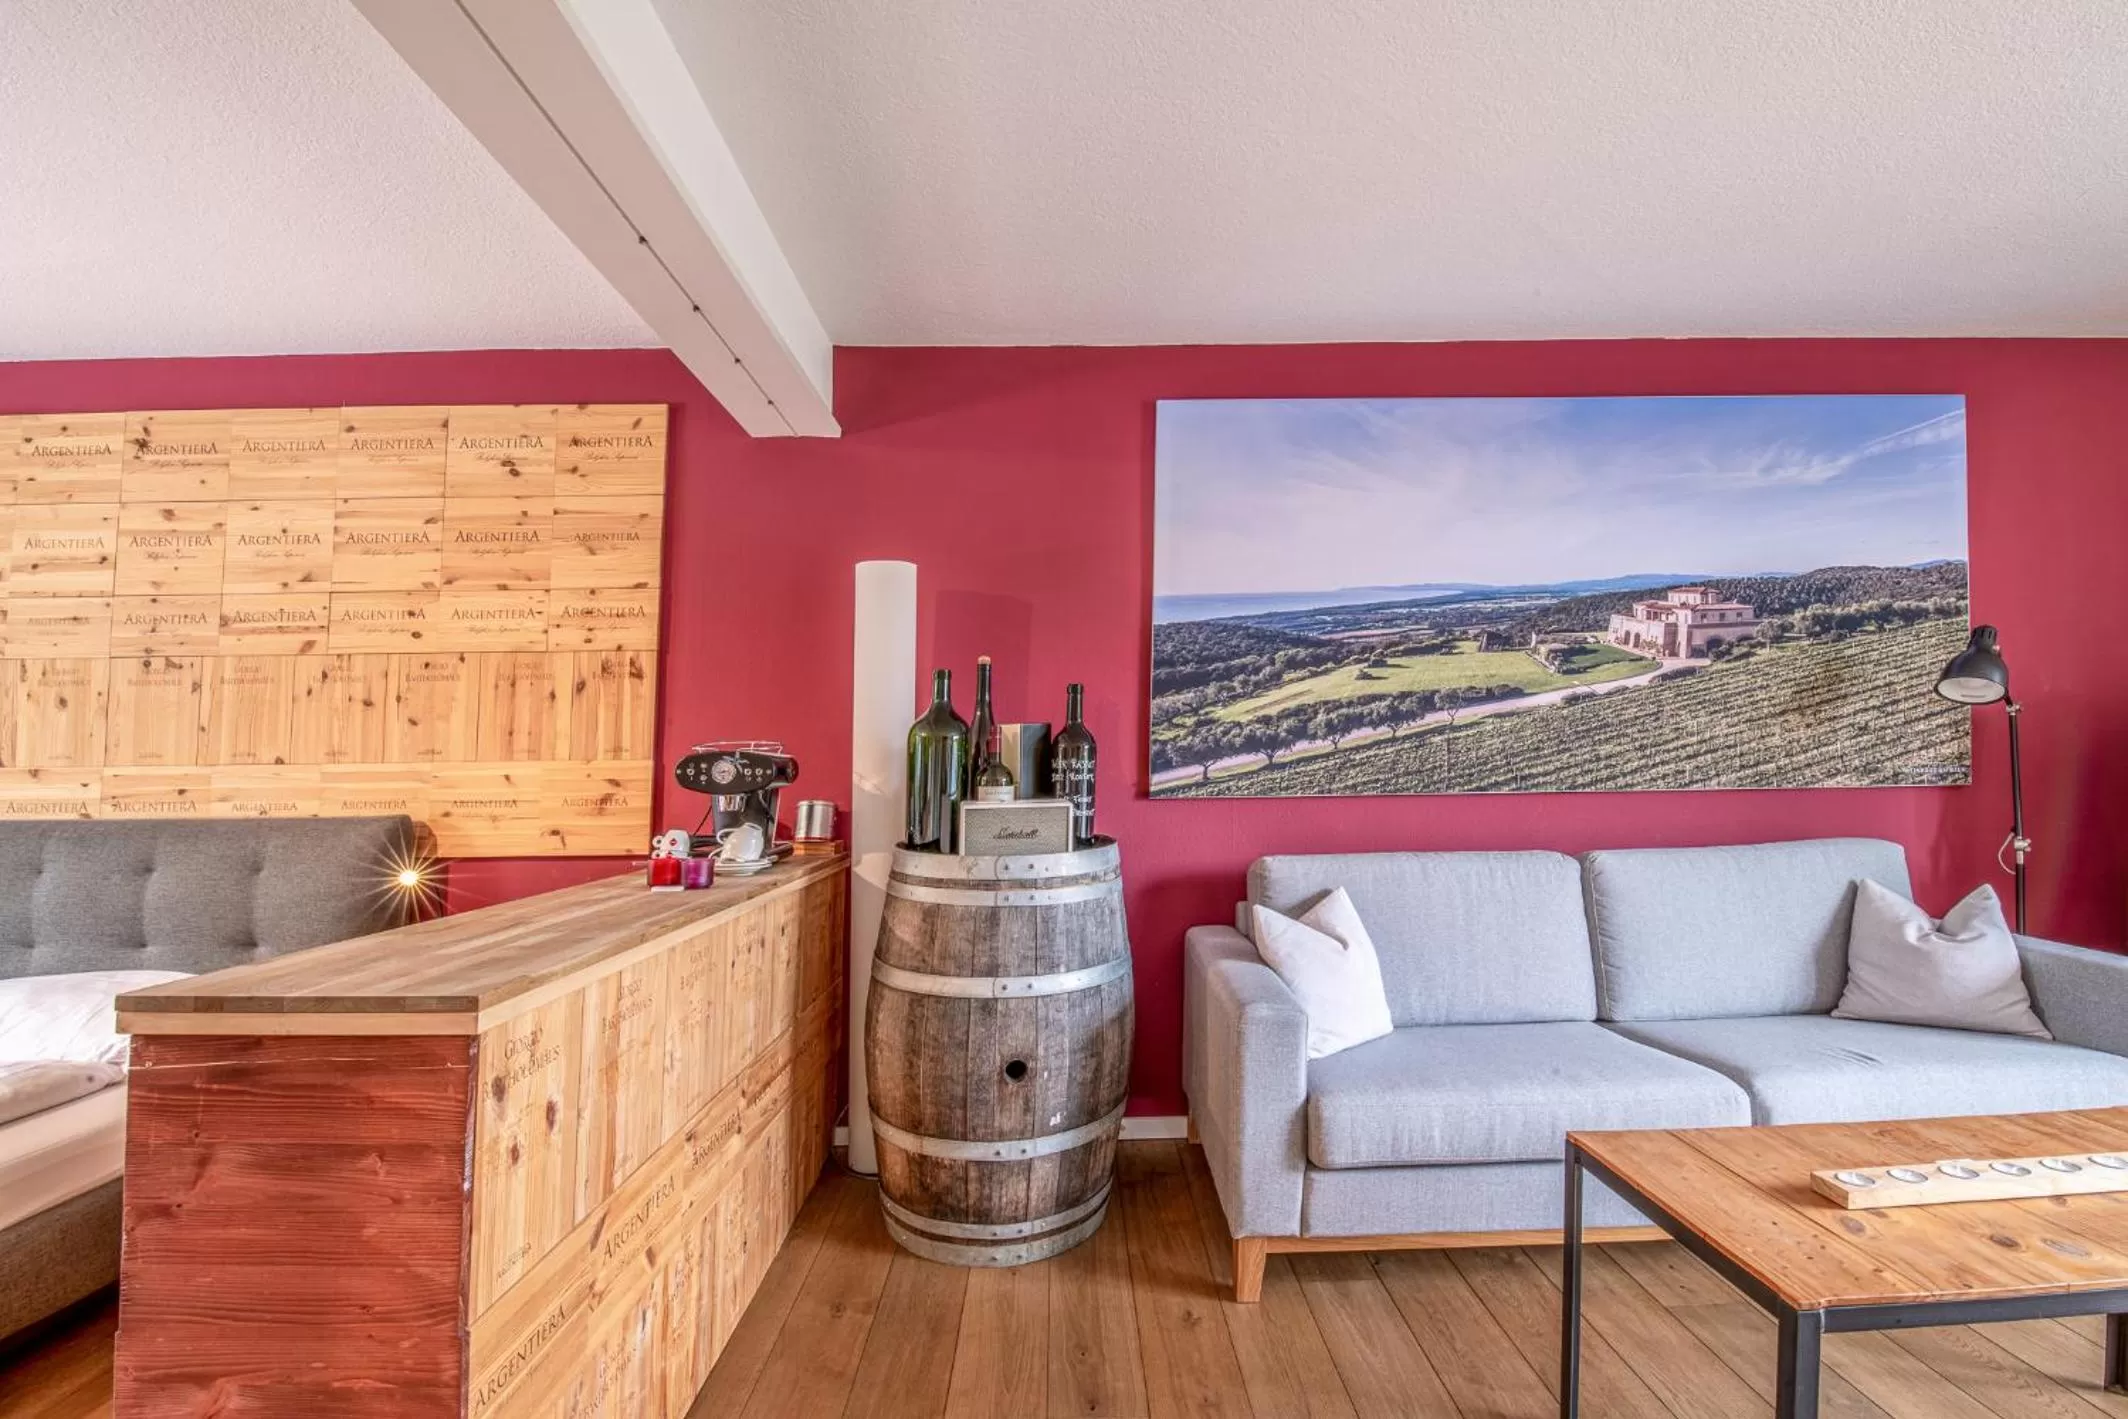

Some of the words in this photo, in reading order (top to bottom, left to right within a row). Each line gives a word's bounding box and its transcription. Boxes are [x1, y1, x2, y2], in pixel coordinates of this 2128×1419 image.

[136, 441, 218, 455] ARGENTIERA
[242, 439, 326, 452] ARGENTIERA
[350, 437, 434, 450] ARGENTIERA
[459, 435, 544, 449] ARGENTIERA
[568, 435, 653, 448] ARGENTIERA
[31, 444, 112, 457] ARGENTIERA
[24, 536, 105, 550] ARGENTIERA
[129, 534, 212, 547] ARGENTIERA
[238, 533, 321, 546] ARGENTIERA
[345, 530, 430, 544] ARGENTIERA
[455, 529, 540, 543] ARGENTIERA
[124, 611, 208, 625] ARGENTIERA
[232, 608, 317, 623] ARGENTIERA
[341, 608, 426, 622] ARGENTIERA
[451, 607, 536, 620] ARGENTIERA
[561, 605, 646, 618] ARGENTIERA
[5, 800, 89, 815] ARGENTIERA
[115, 800, 197, 814] ARGENTIERA
[602, 1175, 676, 1266] ARGENTIERA
[474, 1305, 567, 1417] ARGENTIERA
